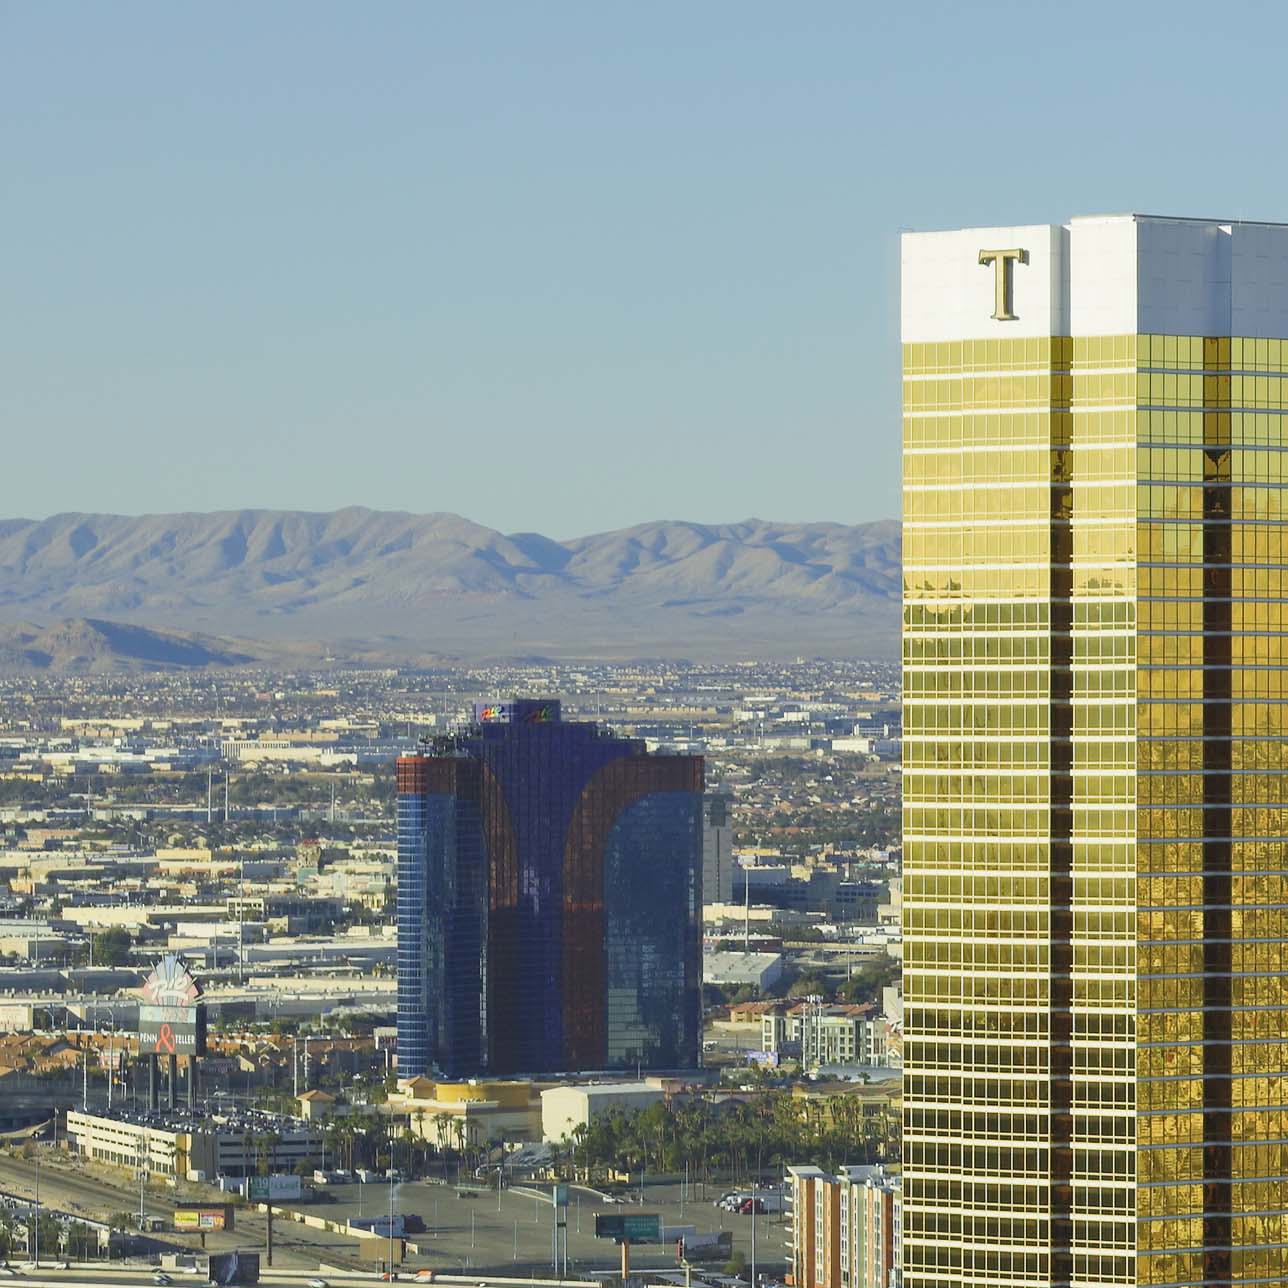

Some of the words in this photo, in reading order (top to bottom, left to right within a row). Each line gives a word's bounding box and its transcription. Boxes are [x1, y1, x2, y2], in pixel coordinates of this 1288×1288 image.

[978, 248, 1030, 321] T
[140, 1032, 158, 1043] PENN
[175, 1033, 196, 1045] TELLER
